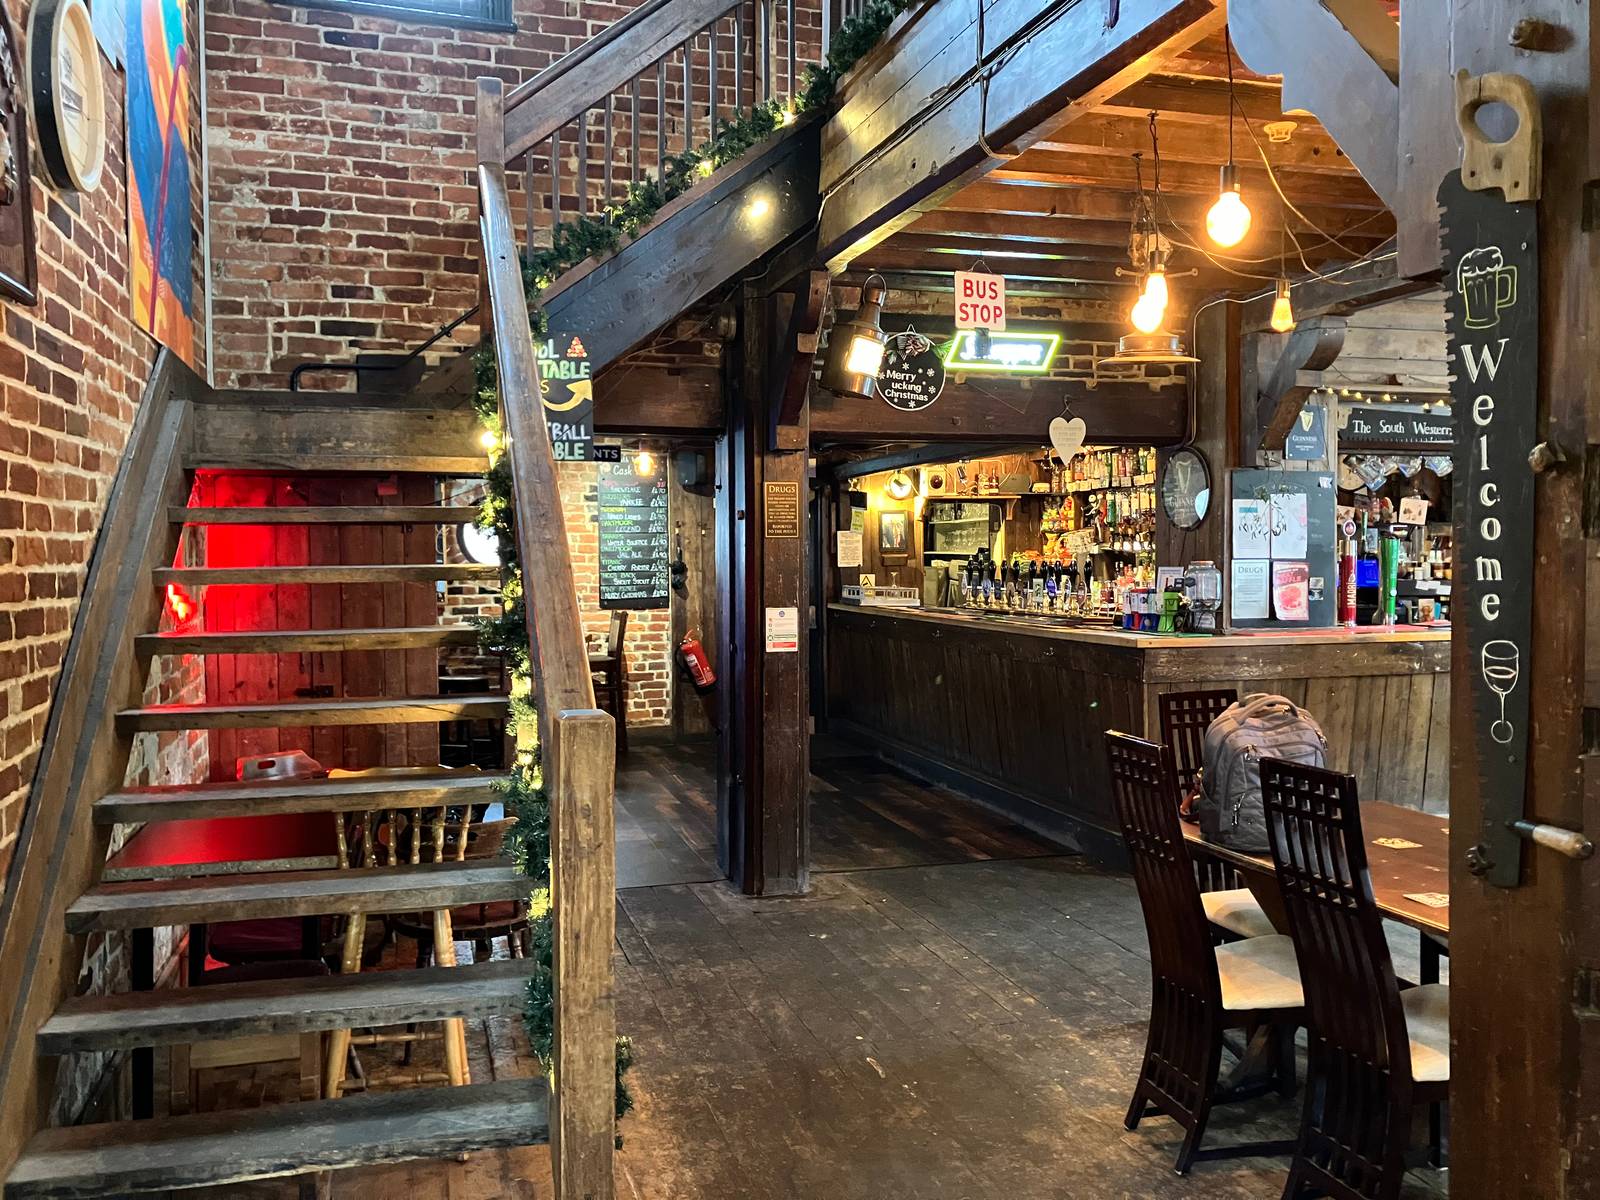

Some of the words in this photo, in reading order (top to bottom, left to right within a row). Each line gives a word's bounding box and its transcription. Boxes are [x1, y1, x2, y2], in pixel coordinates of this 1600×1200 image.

[963, 279, 998, 300] BUS
[959, 303, 1003, 324] STOP
[537, 359, 591, 379] TABLE
[886, 369, 917, 383] Merry
[885, 389, 929, 402] Christmas
[547, 422, 591, 441] BALL
[1352, 419, 1372, 434] The
[1379, 419, 1405, 435] South
[593, 449, 618, 459] NTS
[613, 465, 633, 476] Cask
[1461, 338, 1510, 622] Welcome
[768, 485, 796, 493] DRUGS
[1238, 566, 1264, 574] DRUGS
